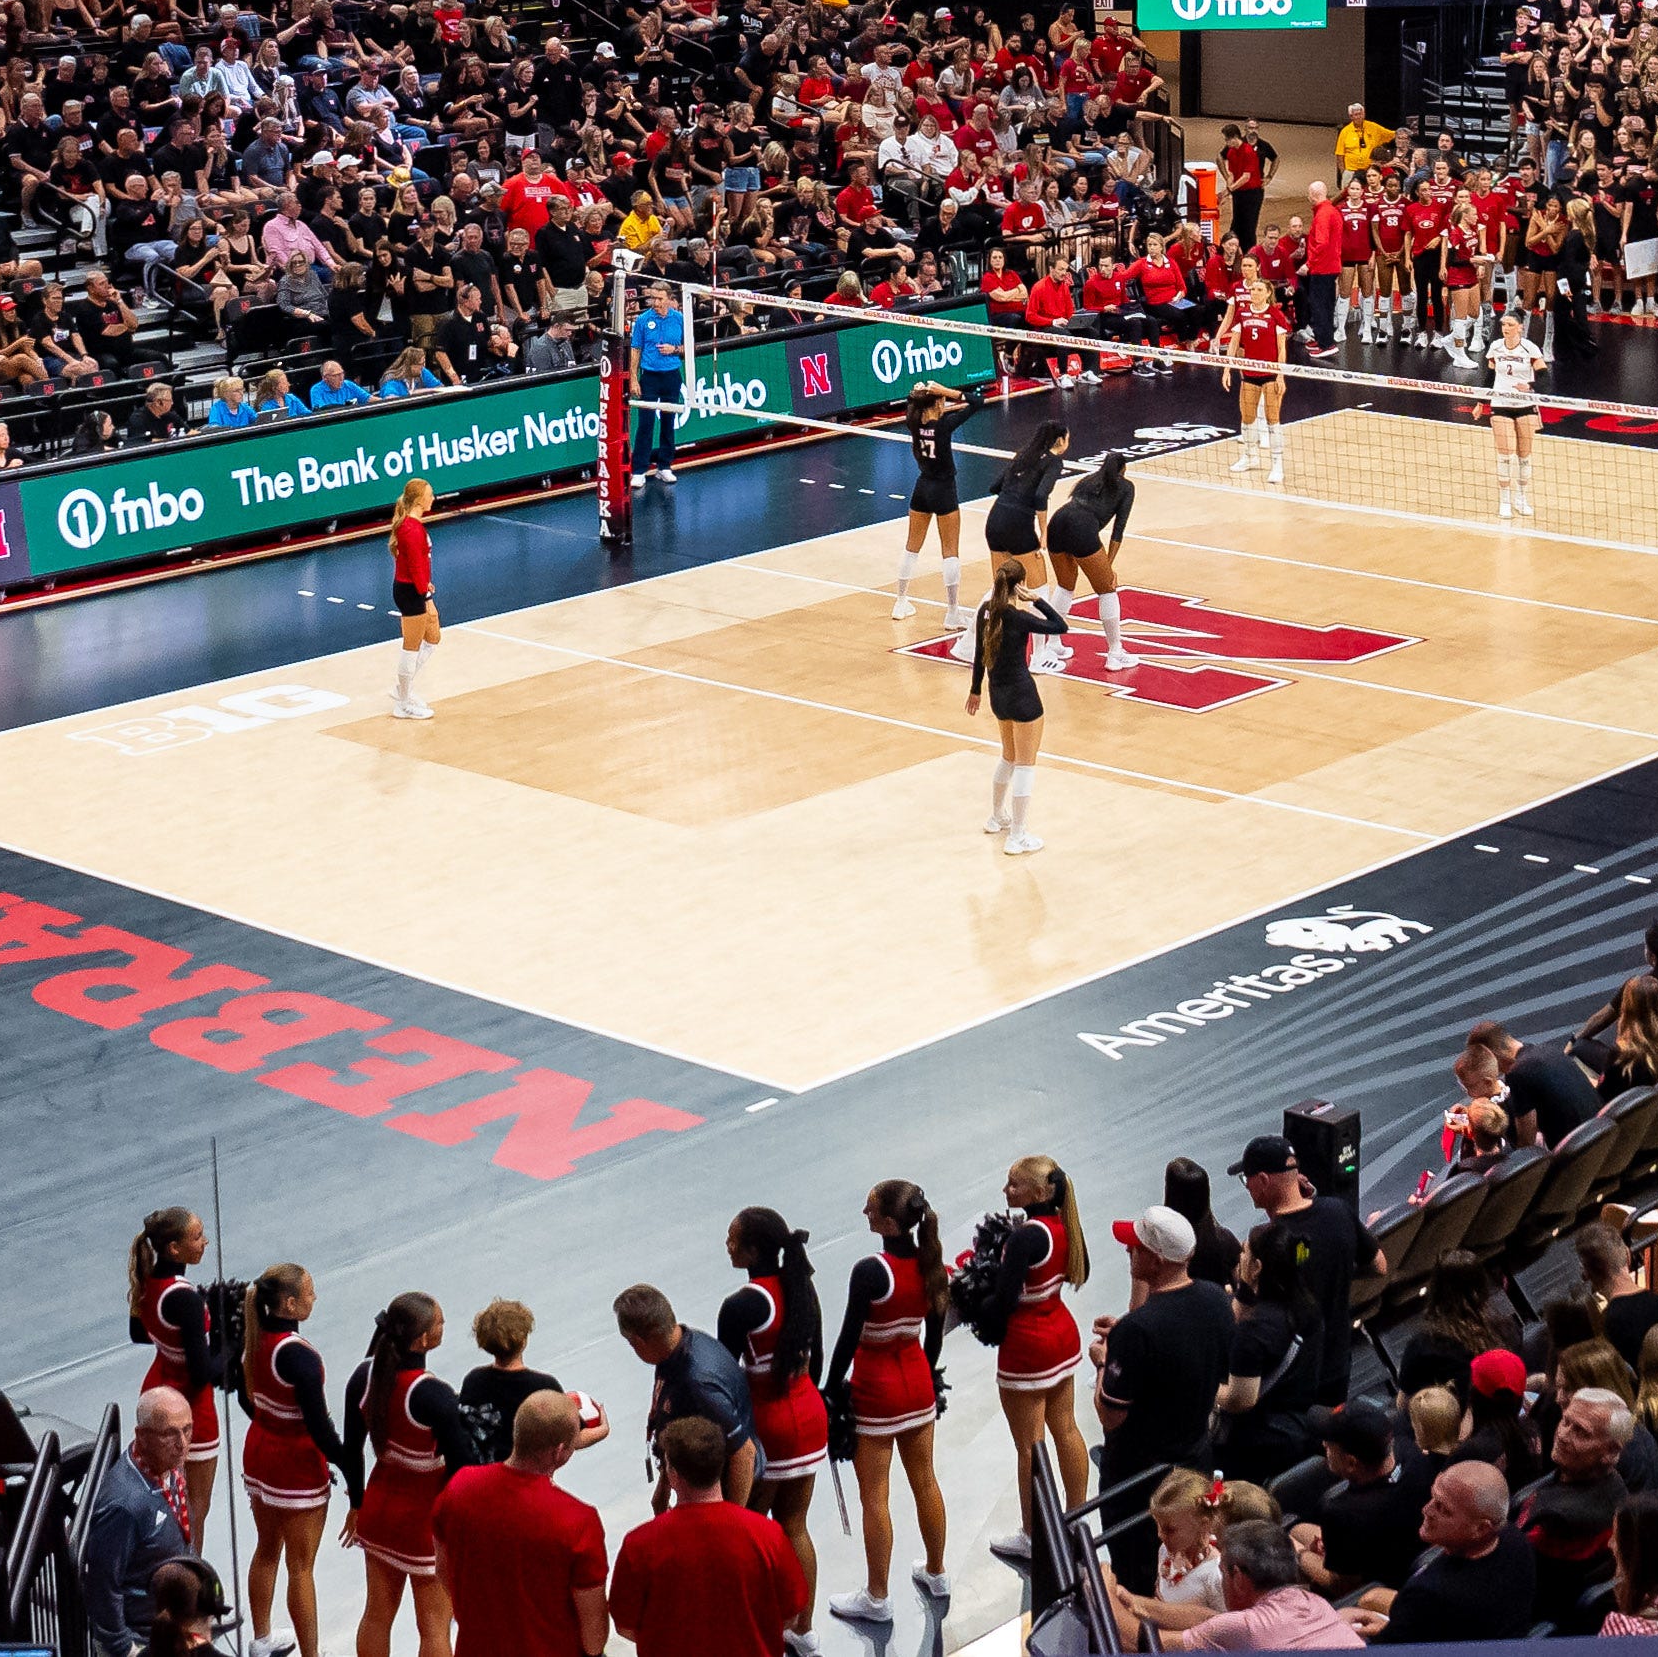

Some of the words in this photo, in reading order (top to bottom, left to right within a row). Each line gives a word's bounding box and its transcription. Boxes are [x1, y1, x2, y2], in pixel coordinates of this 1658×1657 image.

[800, 352, 832, 397] N
[904, 336, 962, 374] fnbo
[1236, 357, 1282, 373] VOLLEYBALL
[1387, 376, 1420, 392] HUSKER
[1421, 380, 1475, 396] VOLLEYBALL
[1587, 399, 1623, 414] HUSKER
[232, 467, 294, 505] The
[299, 447, 379, 493] Bank
[384, 438, 413, 476] of
[419, 425, 519, 470] Husker
[597, 386, 613, 539] NEBRASKA
[111, 482, 204, 534] fnbo
[1076, 948, 1347, 1062] Ameritas
